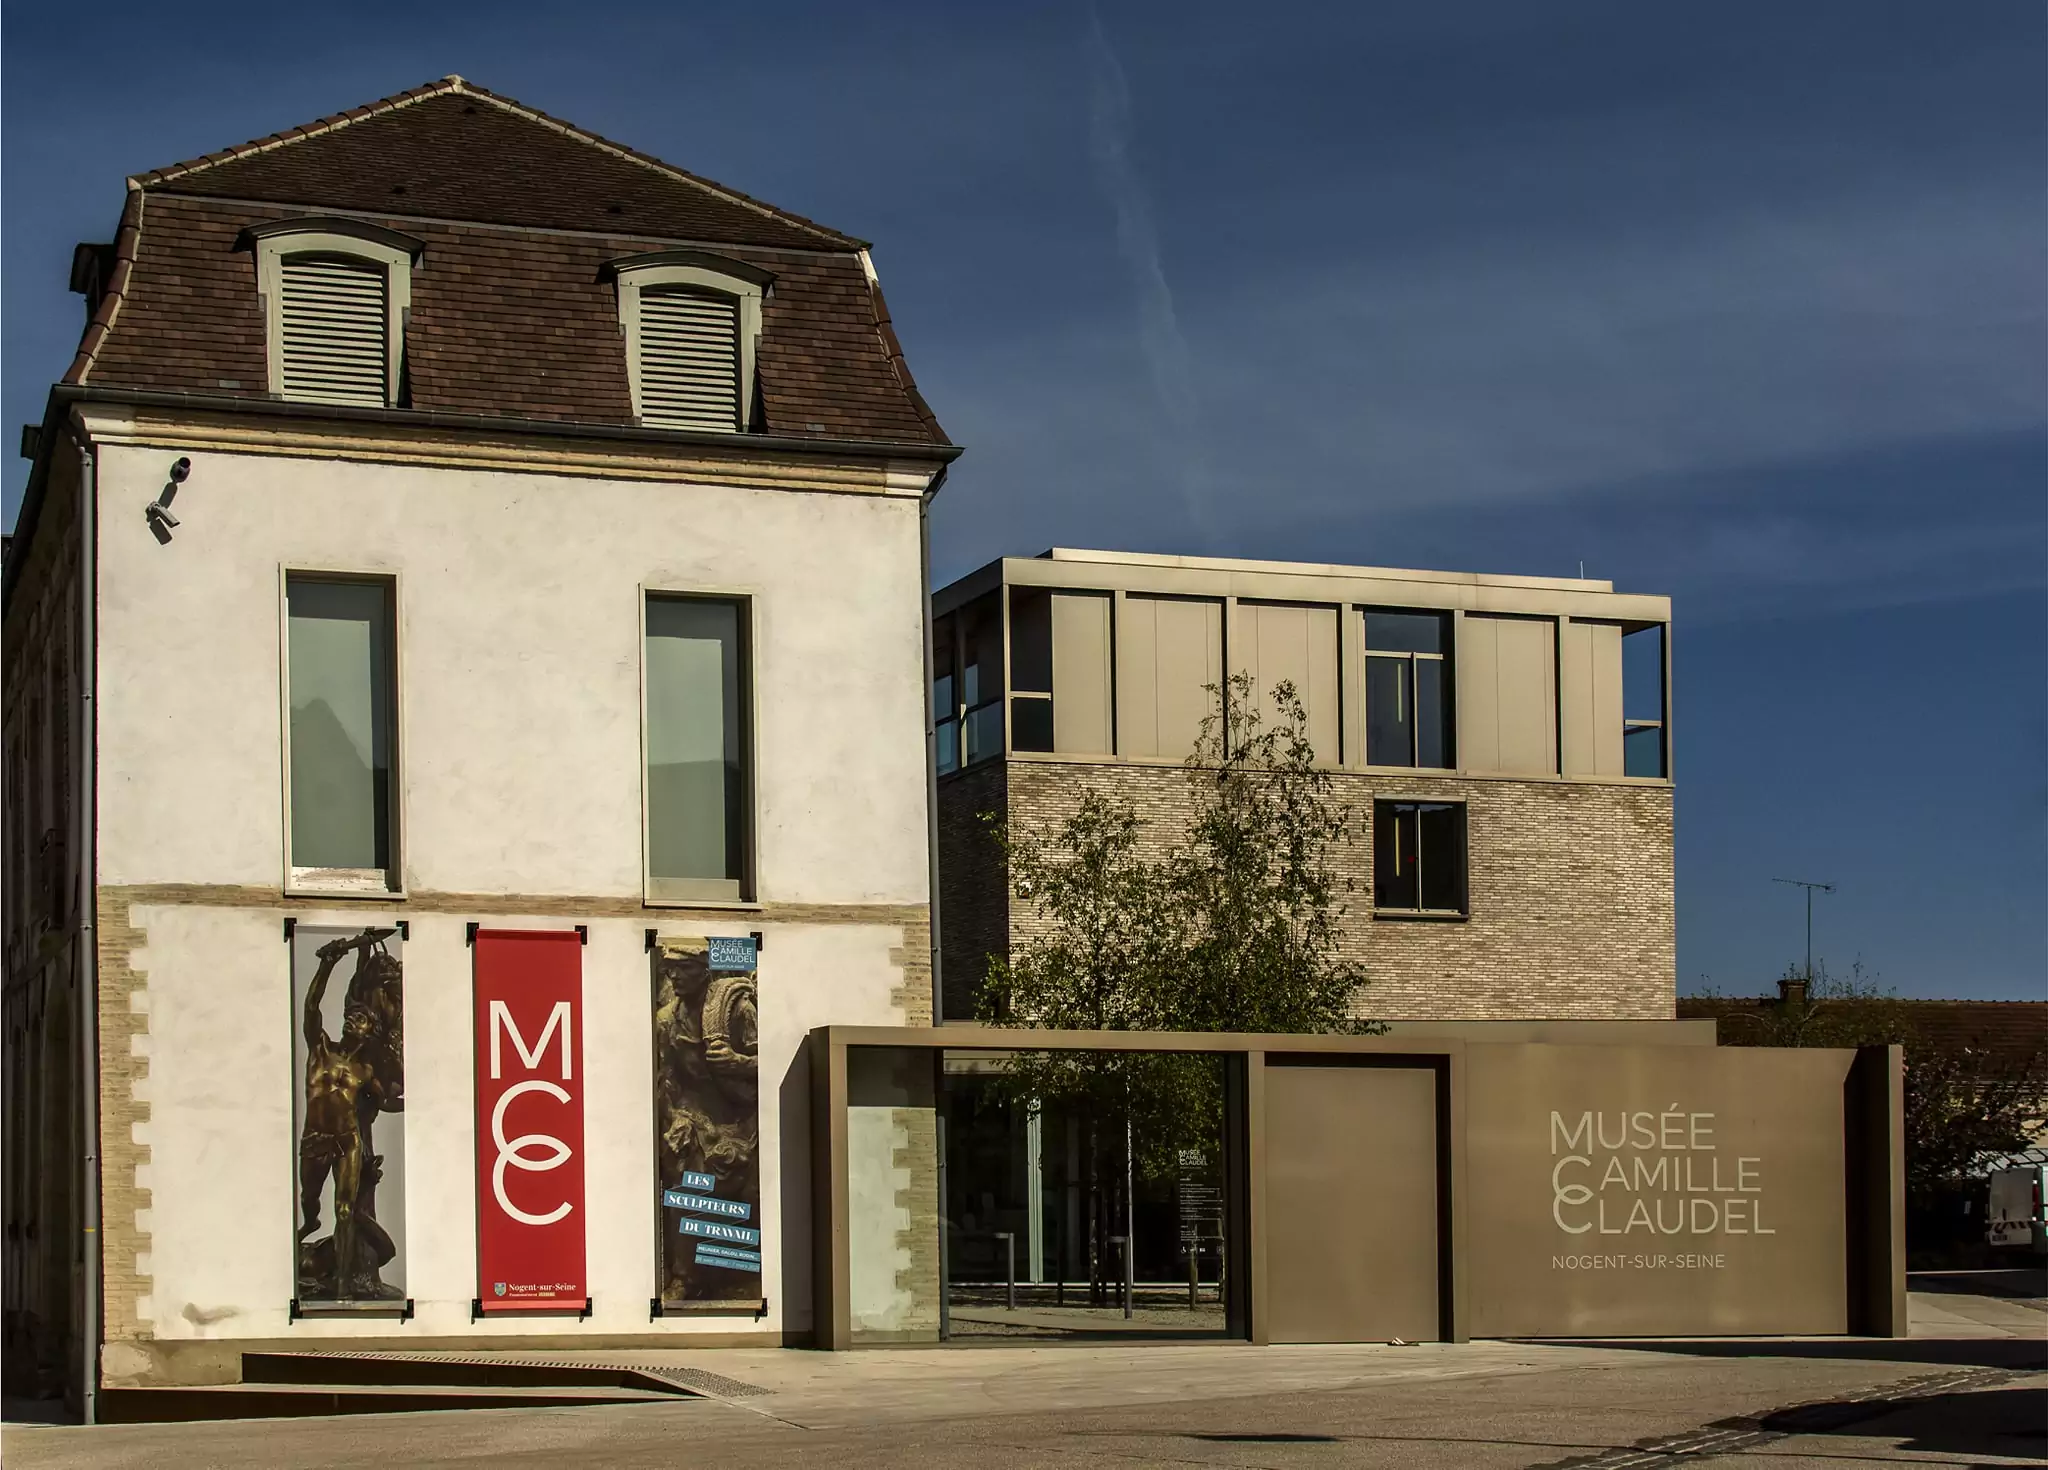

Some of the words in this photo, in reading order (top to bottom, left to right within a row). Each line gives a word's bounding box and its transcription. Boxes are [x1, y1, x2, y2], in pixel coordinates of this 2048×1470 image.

[710, 939, 743, 948] MUSÉE
[710, 947, 753, 956] CAMILLE
[710, 953, 755, 962] CLAUDEL
[1550, 1102, 1716, 1155] MUSÉE
[687, 1174, 710, 1187] LES
[1552, 1155, 1762, 1204] CAMILLE
[668, 1194, 745, 1215] SCULPTEURS
[1552, 1185, 1776, 1234] CLAUDEL
[684, 1221, 700, 1233] DU
[704, 1224, 753, 1241] TRAVAIL
[1551, 1254, 1726, 1270] NOGENT-SUR-SEINE
[508, 1283, 576, 1292] Nogent-sur-Seine
